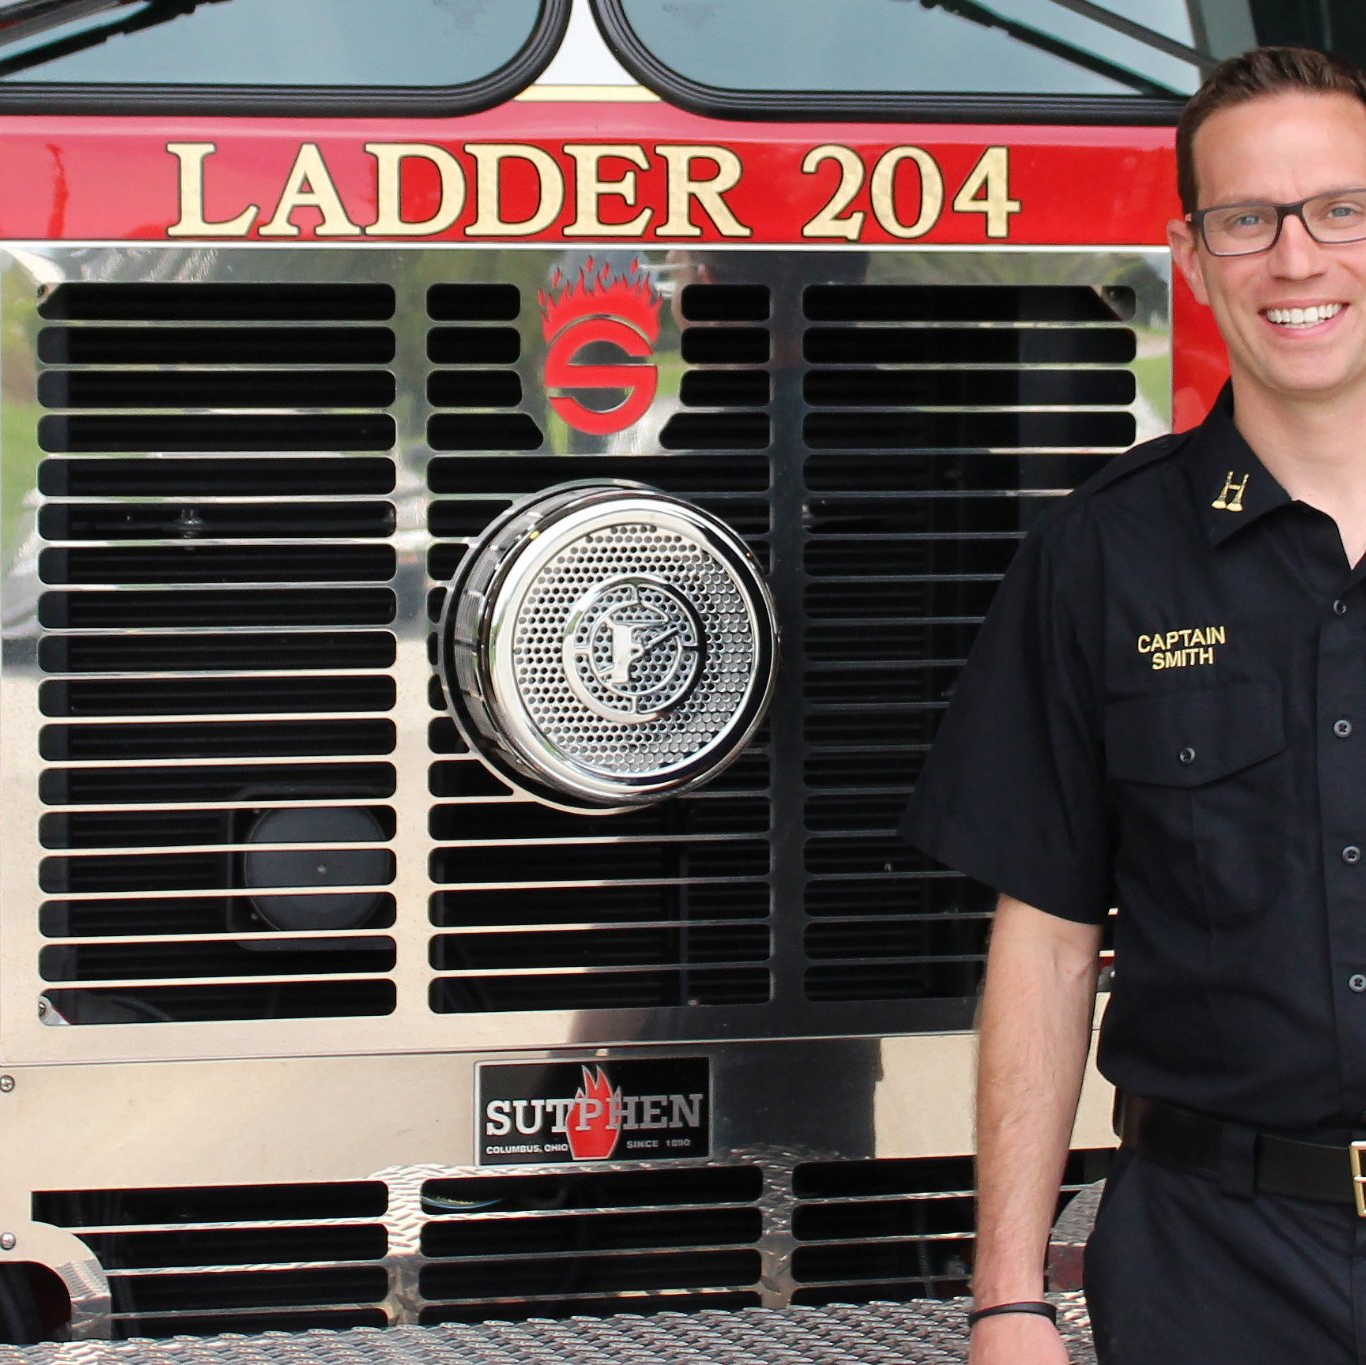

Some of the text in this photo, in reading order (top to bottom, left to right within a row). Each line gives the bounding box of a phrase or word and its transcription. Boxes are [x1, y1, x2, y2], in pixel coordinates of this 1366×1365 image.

[165, 141, 1022, 241] LADDER 204
[1137, 626, 1226, 653] CAPTAIN
[1152, 647, 1214, 670] SMITH
[486, 1093, 704, 1136] SUTPHEN
[544, 1143, 569, 1152] OHIO
[626, 1139, 659, 1149] SINCE
